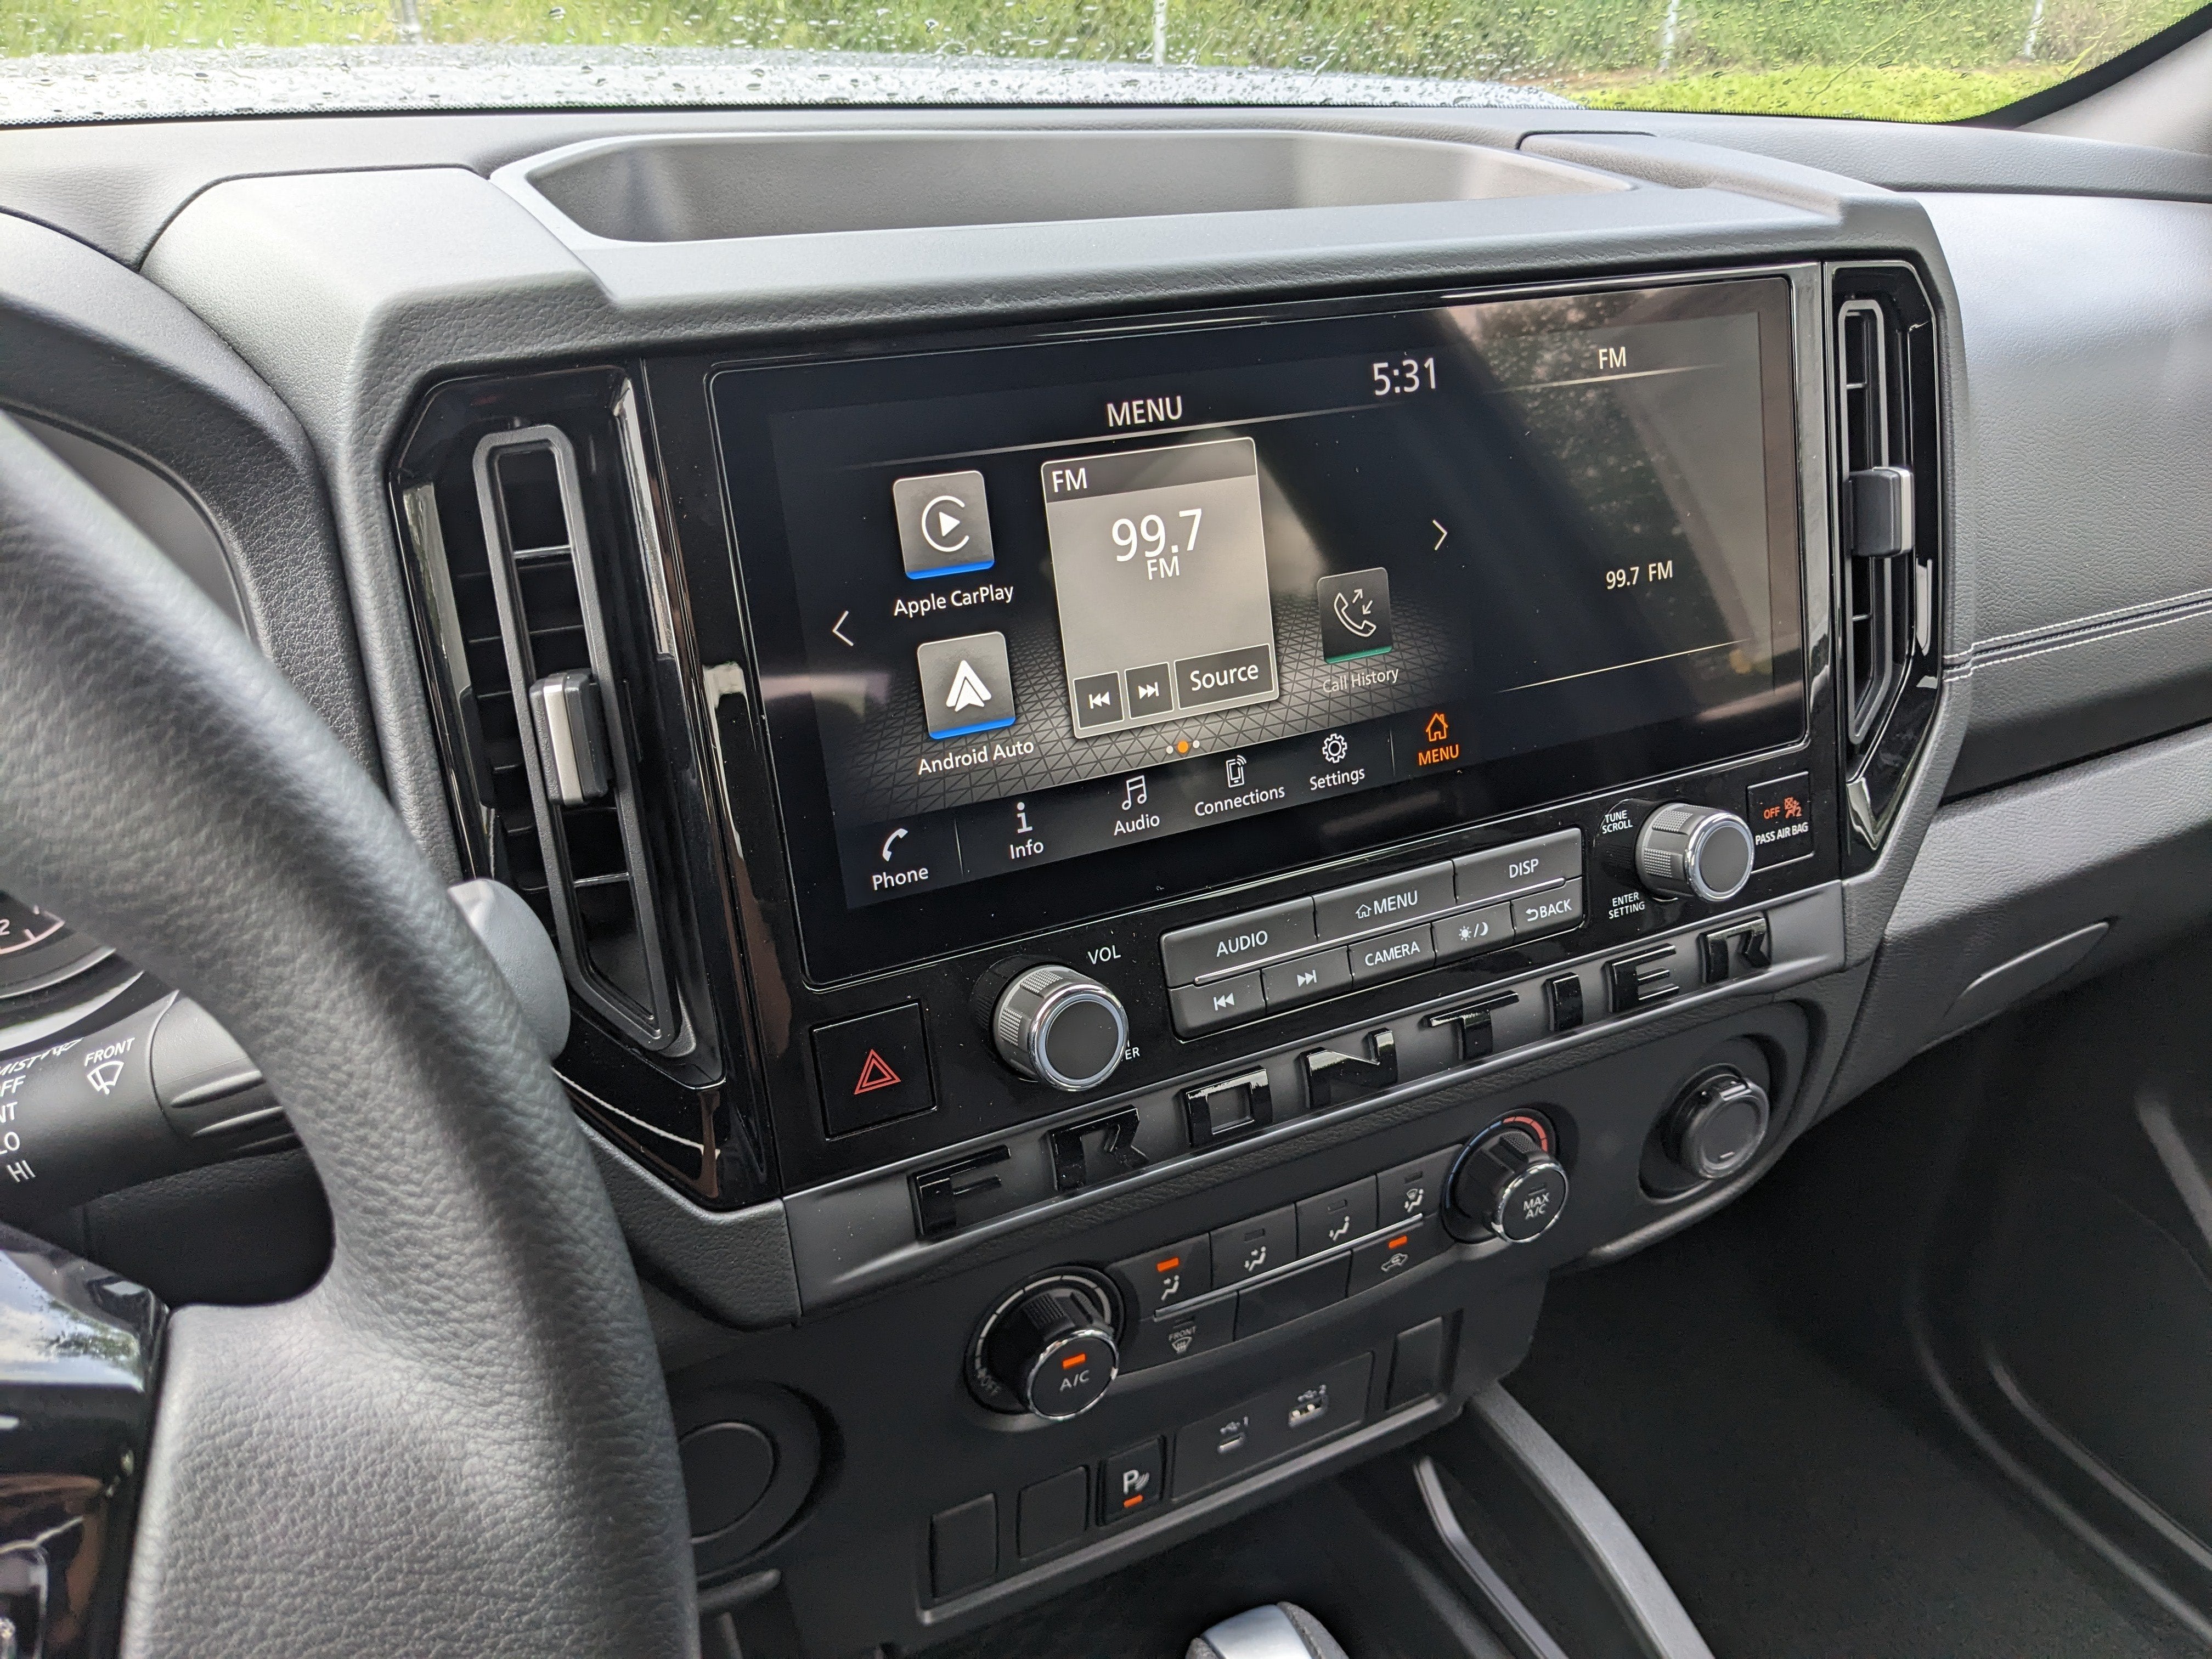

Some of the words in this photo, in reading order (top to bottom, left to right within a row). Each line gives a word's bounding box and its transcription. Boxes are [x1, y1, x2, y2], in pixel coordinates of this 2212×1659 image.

[1599, 347, 1626, 369] FM
[1373, 358, 1435, 395] 5:31
[1107, 396, 1182, 427] MENU
[1052, 468, 1087, 492] FM
[1111, 508, 1202, 563] 99.7
[1147, 555, 1180, 580] FM
[1606, 567, 1639, 589] 99.7
[1649, 561, 1672, 582] FM
[894, 594, 946, 618] Apple
[951, 585, 1013, 606] CarPlay
[1190, 665, 1258, 691] Source
[1323, 675, 1347, 693] Call
[1351, 669, 1399, 688] History
[918, 746, 988, 775] Android
[993, 741, 1034, 760] Auto
[1419, 744, 1458, 765] MENU
[1310, 769, 1364, 790] Settings
[1195, 785, 1285, 816] Connections
[1605, 810, 1628, 823] TUNE
[1764, 806, 1780, 819] OFF
[1114, 815, 1160, 836] Audio
[1602, 819, 1634, 834] SCROLL
[1756, 831, 1775, 845] PASS
[1777, 827, 1791, 839] AIR
[1792, 822, 1808, 835] BAG
[1011, 839, 1043, 859] Info
[872, 868, 928, 890] Phone
[1509, 859, 1538, 878] DISP
[1374, 890, 1417, 915] MENU
[1540, 899, 1572, 918] BACK
[1609, 901, 1645, 919] SETTING
[1612, 891, 1639, 907] ENTER
[1088, 945, 1121, 964] VOL
[1217, 931, 1267, 957] AUDIO
[1365, 941, 1420, 966] CAMERA
[84, 1037, 135, 1066] FRONT
[0, 1075, 26, 1097] FF
[908, 915, 1771, 1242] FRONTIER
[7, 1160, 35, 1182] HI
[1523, 1192, 1550, 1211] MAX
[1525, 1203, 1546, 1220] A/C
[1059, 1369, 1090, 1392] A/C
